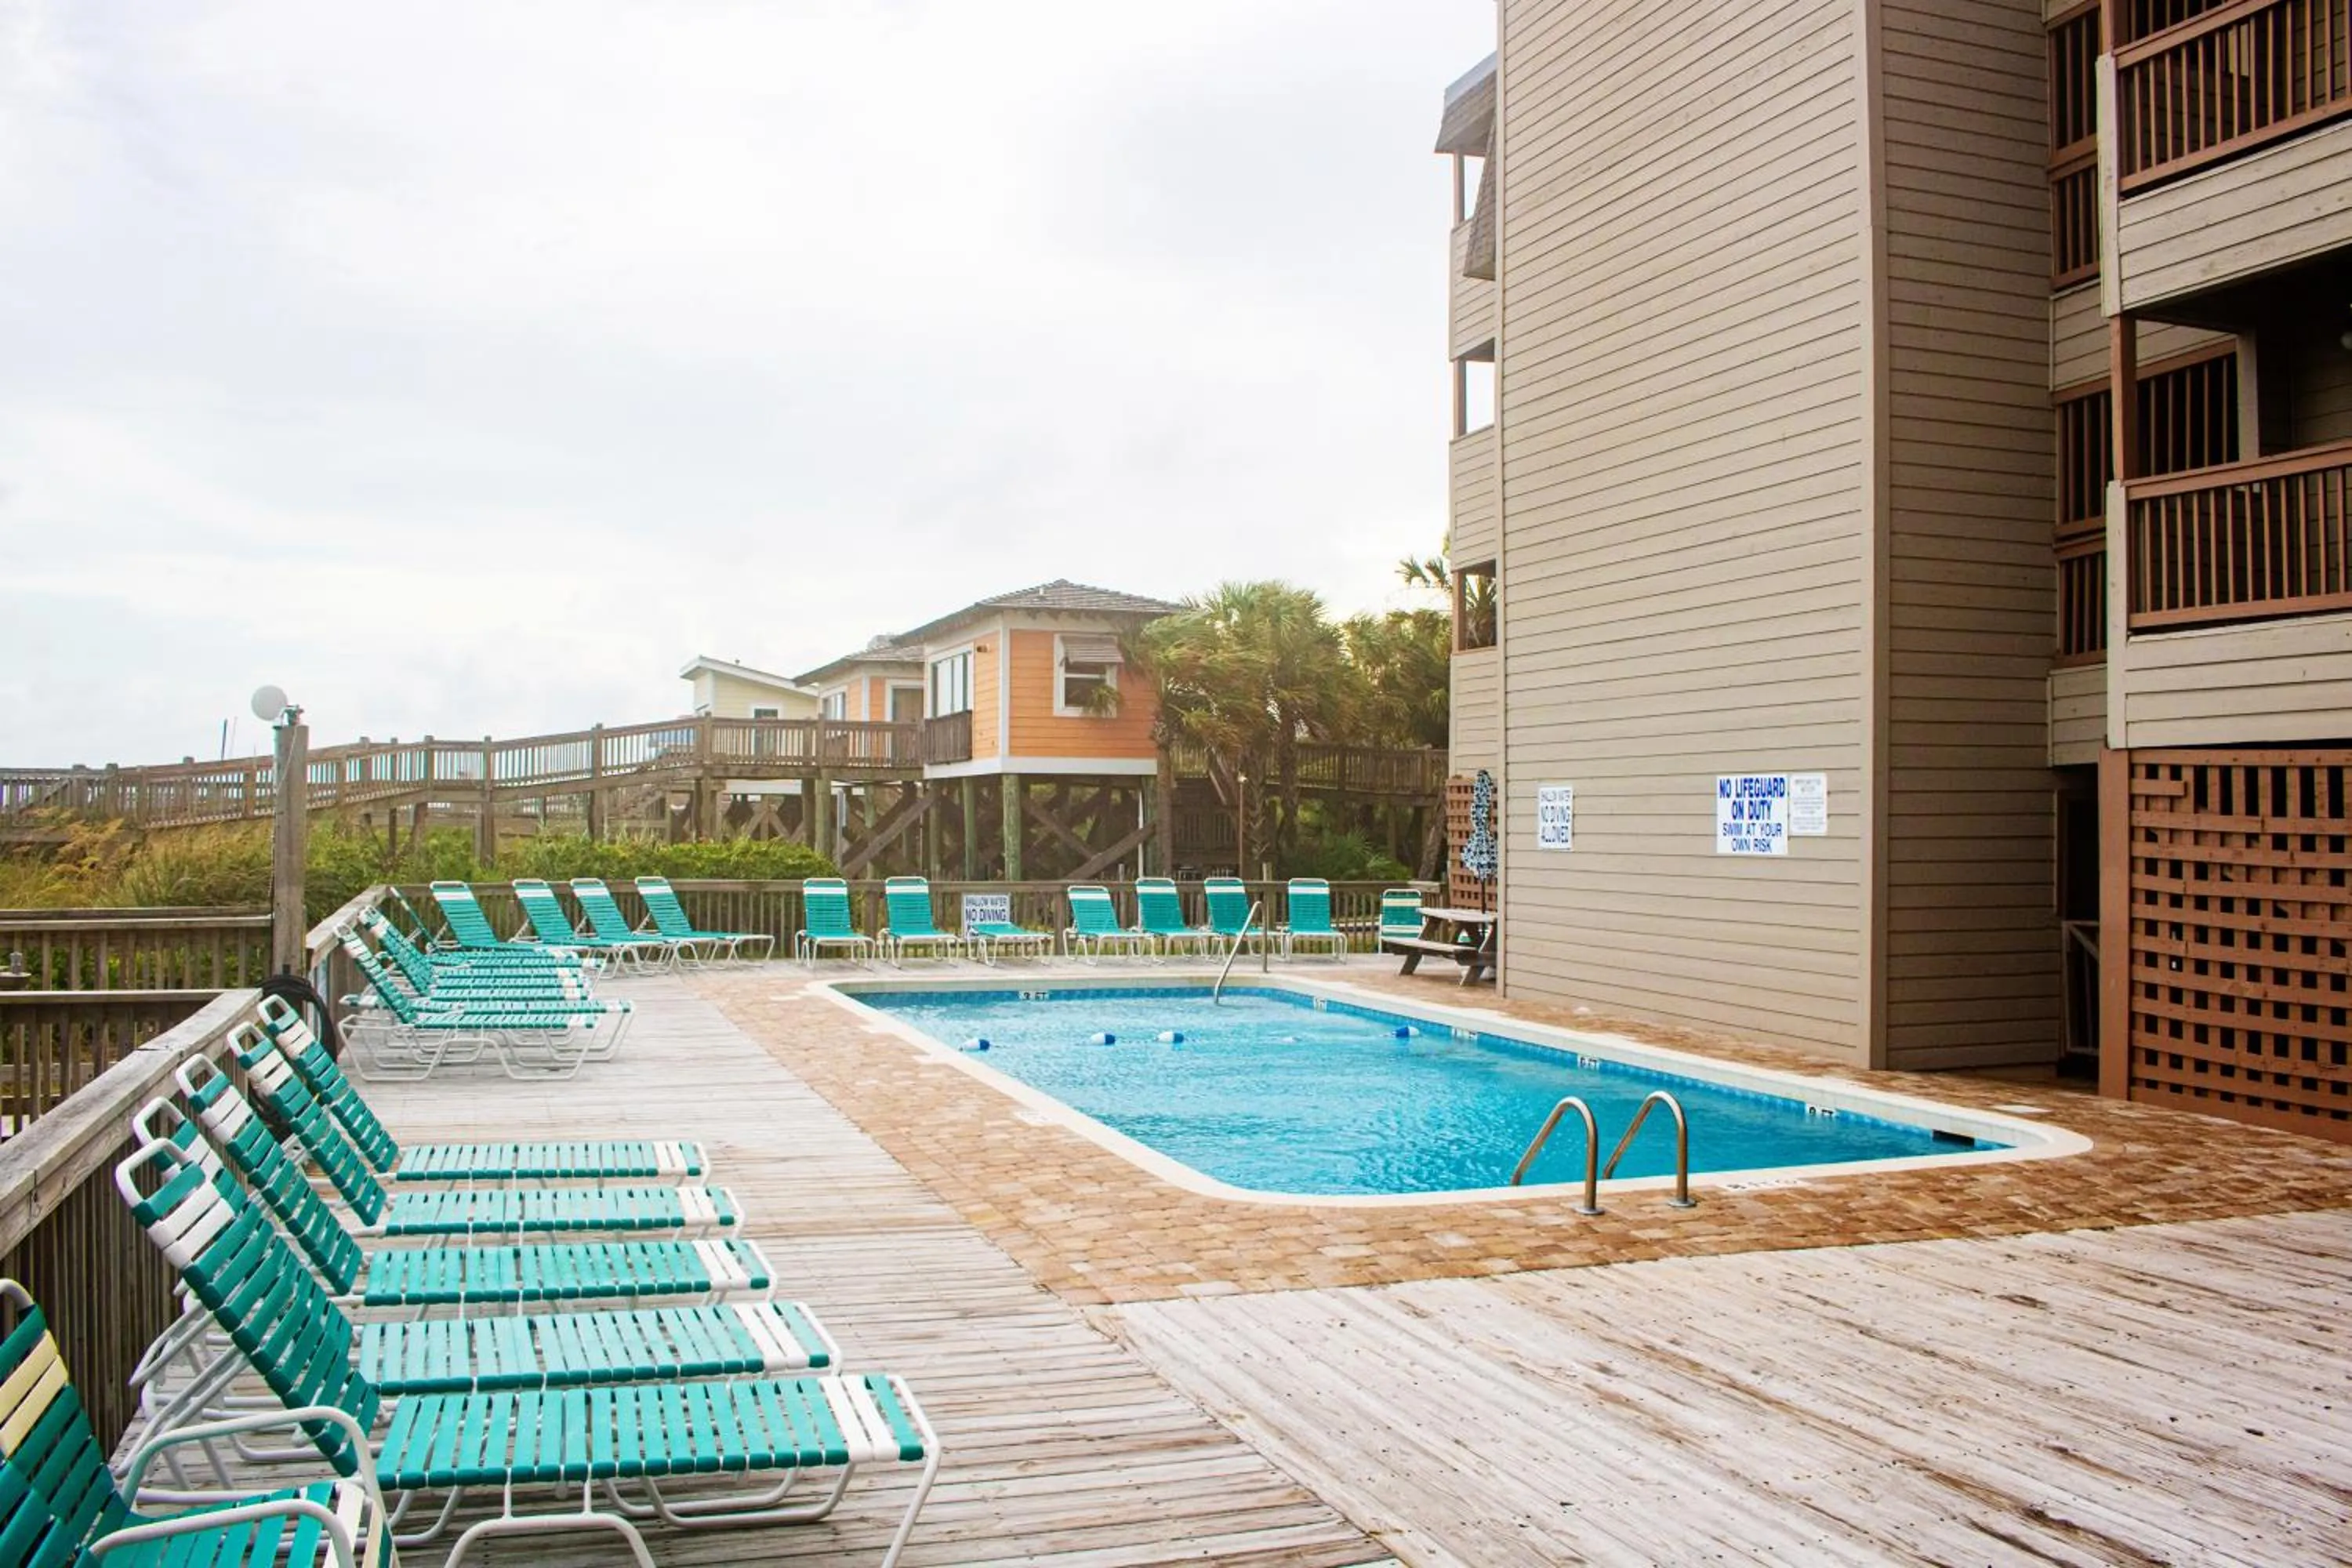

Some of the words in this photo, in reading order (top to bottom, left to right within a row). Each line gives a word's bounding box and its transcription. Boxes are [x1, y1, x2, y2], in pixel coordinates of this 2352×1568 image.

[1719, 779, 1732, 798] NO
[1735, 778, 1785, 798] LIFEGUARD
[1541, 805, 1549, 822] NO
[1550, 805, 1570, 822] DIVING
[1731, 800, 1744, 820] ON
[1748, 800, 1773, 820] DUTY
[1541, 826, 1569, 843] ALLOWED
[1722, 822, 1743, 837] SWIM
[1746, 822, 1756, 836] AT
[1760, 822, 1782, 837] YOUR
[1731, 838, 1751, 852] OWN
[1753, 838, 1772, 852] RISK
[966, 896, 988, 907] SHALLOW
[990, 896, 1007, 907] WATER
[966, 909, 977, 922] NO
[979, 909, 1006, 922] DIVING
